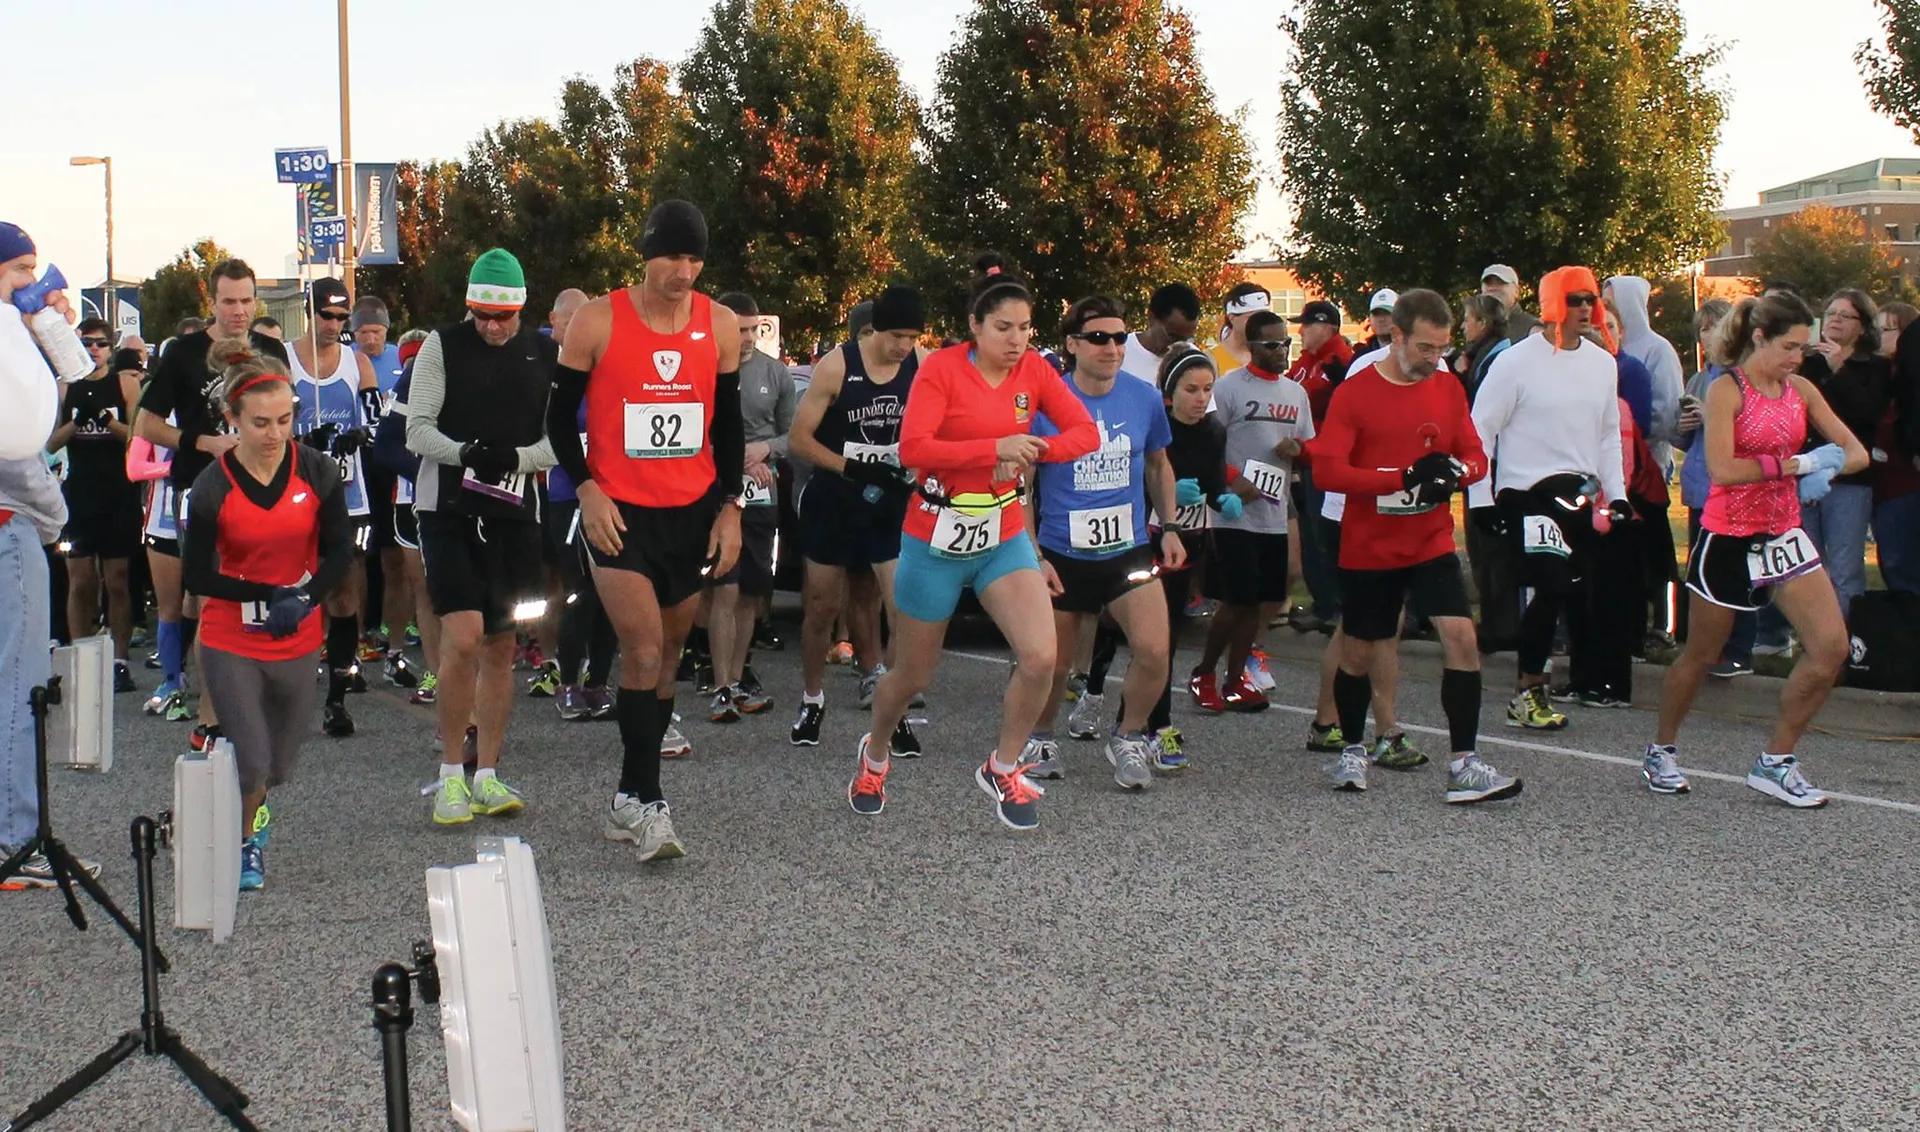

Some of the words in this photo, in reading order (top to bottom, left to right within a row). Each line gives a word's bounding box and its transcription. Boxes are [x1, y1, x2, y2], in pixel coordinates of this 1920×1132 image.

[280, 154, 327, 172] 1:30
[314, 222, 344, 237] 3:30
[121, 316, 137, 325] UIS
[847, 402, 885, 422] ILLINOIS
[1244, 400, 1260, 418] 2
[1268, 402, 1299, 419] RUN
[650, 414, 682, 448] 82
[1073, 457, 1131, 474] CHICAGO
[1074, 468, 1130, 484] MARATHON
[1253, 469, 1282, 497] 1112
[744, 479, 754, 500] 6
[948, 519, 989, 551] 275
[1088, 515, 1121, 546] 311
